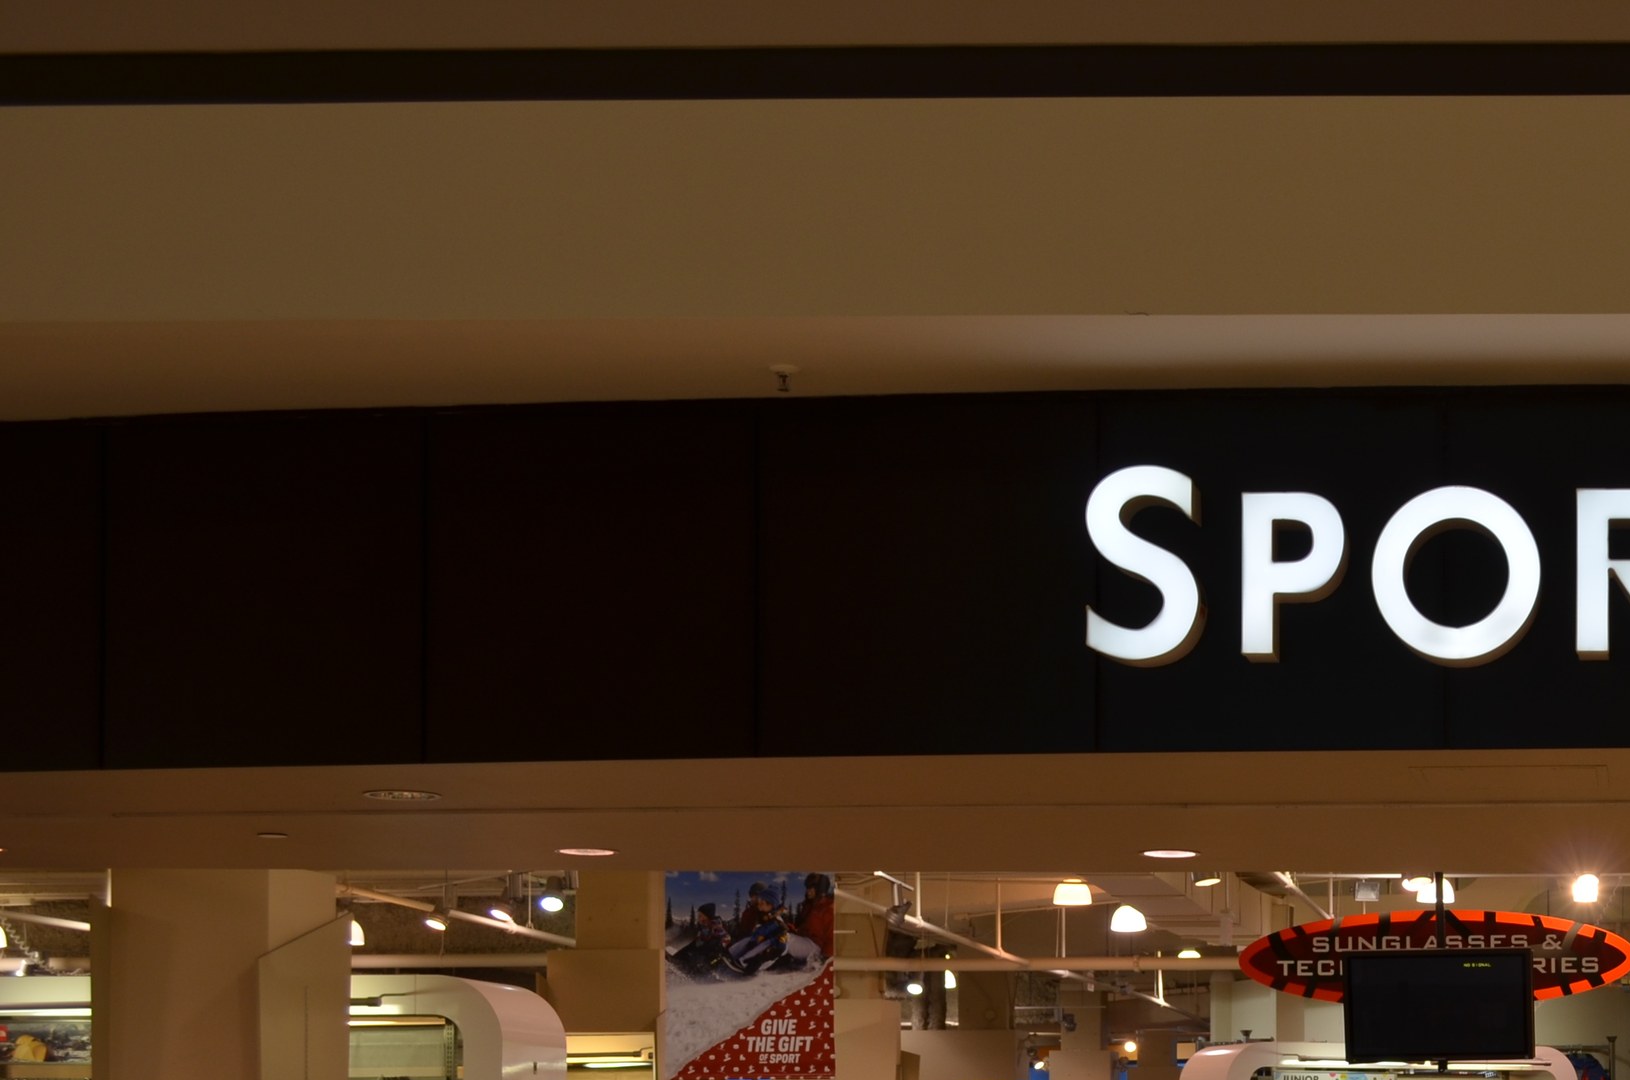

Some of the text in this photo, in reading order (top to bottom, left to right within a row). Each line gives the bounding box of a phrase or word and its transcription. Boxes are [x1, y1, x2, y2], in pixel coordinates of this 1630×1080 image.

[1312, 934, 1563, 953] SUNGLASSES &
[1276, 960, 1343, 977] TEC
[761, 1018, 798, 1035] GIVE
[746, 1035, 814, 1053] THE GIFT
[758, 1053, 801, 1064] OF SPORT
